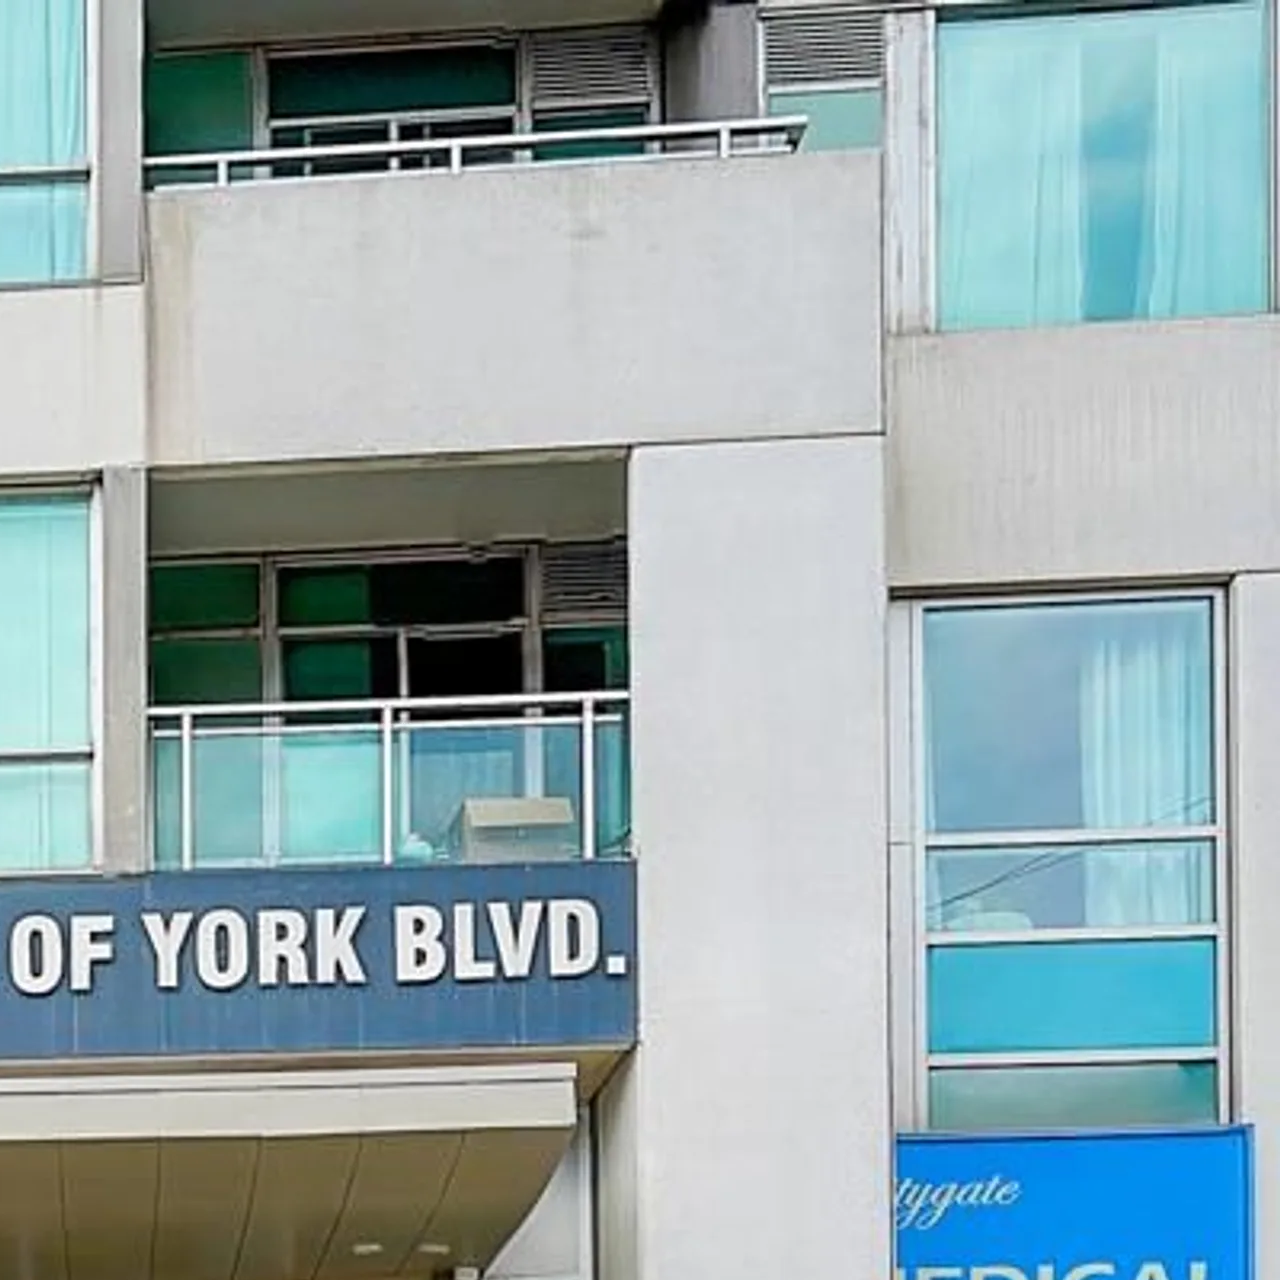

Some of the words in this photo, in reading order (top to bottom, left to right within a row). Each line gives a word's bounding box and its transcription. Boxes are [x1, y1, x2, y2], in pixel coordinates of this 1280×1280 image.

[8, 913, 115, 996] OF
[142, 904, 369, 991] YORK
[393, 898, 628, 984] BLVD.
